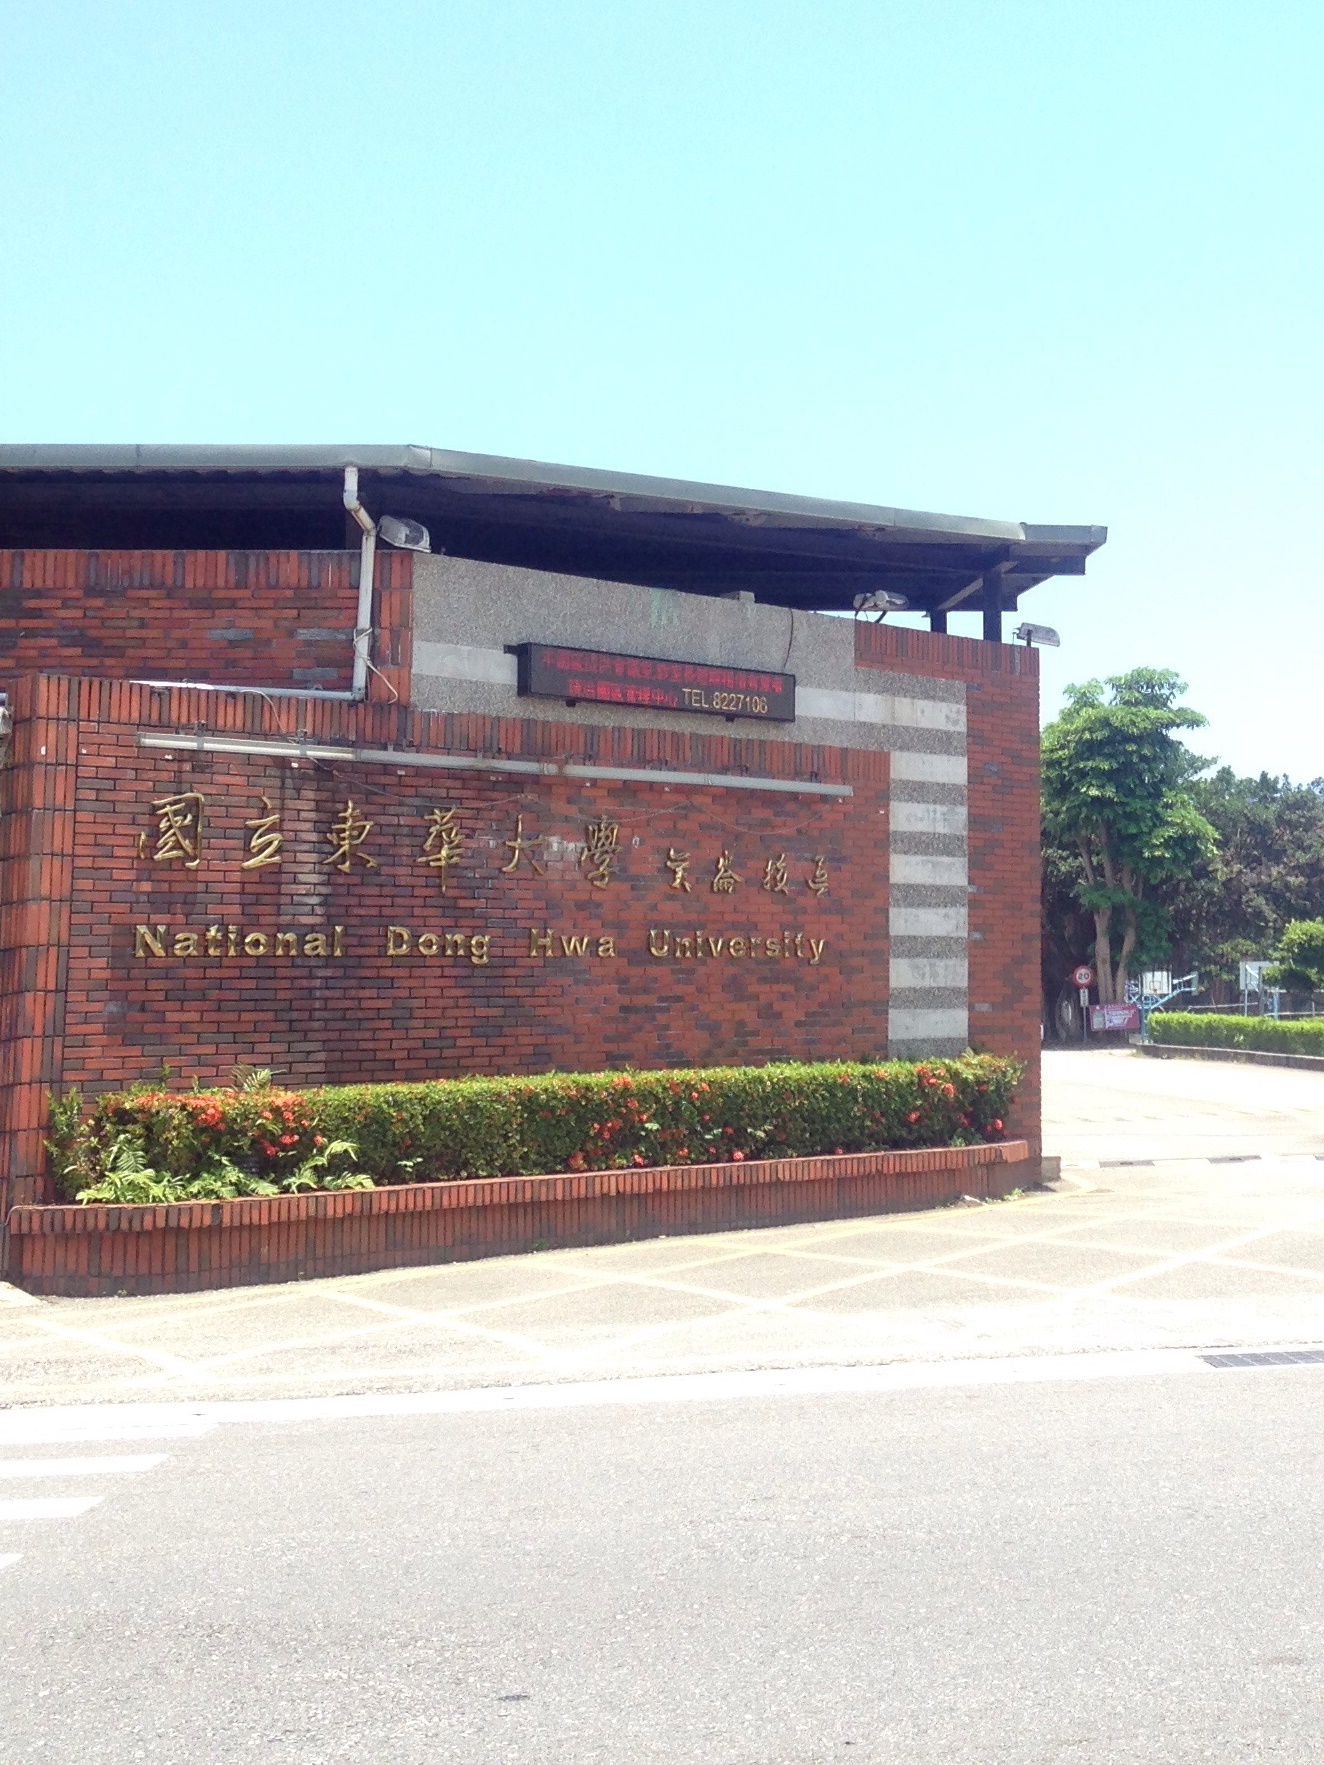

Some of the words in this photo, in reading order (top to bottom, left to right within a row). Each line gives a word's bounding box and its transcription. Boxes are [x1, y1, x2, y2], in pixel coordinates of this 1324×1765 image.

[137, 793, 624, 894] 國立東華大學
[133, 924, 345, 958] National
[386, 926, 492, 966] Dong
[530, 928, 617, 958] Hwa
[649, 929, 826, 965] University
